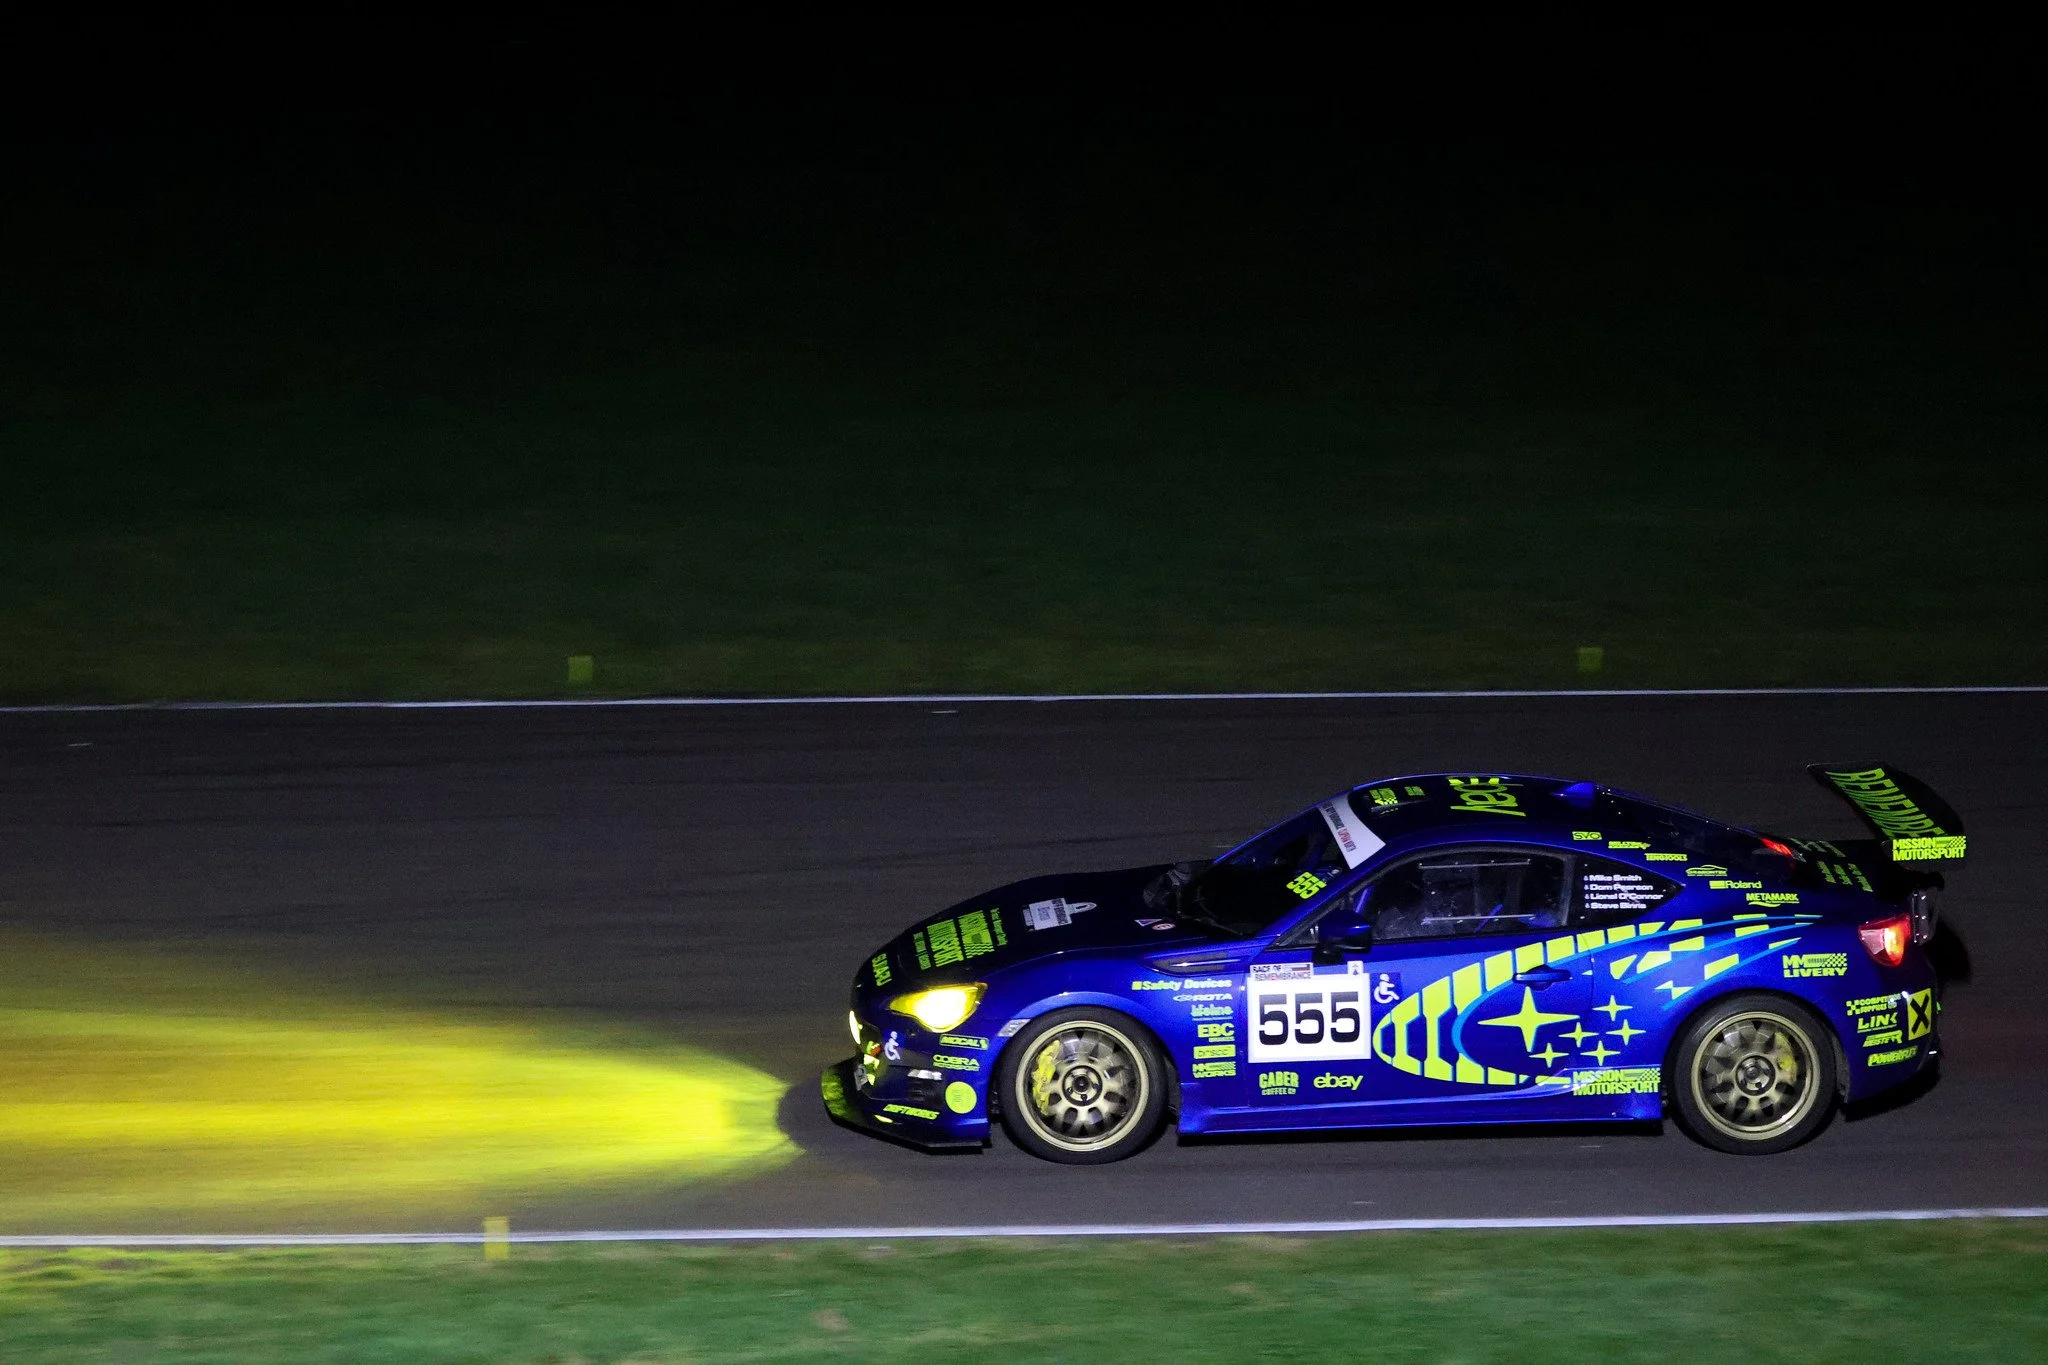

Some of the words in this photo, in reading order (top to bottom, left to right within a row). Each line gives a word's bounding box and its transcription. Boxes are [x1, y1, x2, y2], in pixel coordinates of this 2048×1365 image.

[1573, 832, 1601, 840] SVO
[1892, 837, 1935, 850] MISSION
[1892, 847, 1965, 861] MOTORSPORT
[1613, 874, 1642, 882] Smith
[1286, 872, 1327, 899] 555
[1613, 883, 1654, 891] Pearson
[1725, 880, 1763, 889] Roland
[1618, 892, 1664, 900] O'Connor
[1746, 892, 1800, 902] METAMARK
[1782, 954, 1806, 969] MM
[1253, 965, 1271, 973] RACE
[1273, 964, 1282, 972] OF
[1783, 967, 1848, 978] LIVERY
[1255, 972, 1311, 981] REMEMBRANCE
[1141, 980, 1182, 991] Safety
[1183, 978, 1233, 989] Devices
[1192, 993, 1233, 1001] ROTA
[1258, 991, 1361, 1045] 555
[1858, 1012, 1898, 1030] LINK
[1197, 1022, 1235, 1038] EBC
[933, 1054, 980, 1066] COBRA
[1193, 1069, 1237, 1078] WORKS
[1572, 1070, 1624, 1084] MISSION
[1313, 1072, 1364, 1090] ebay
[1261, 1087, 1288, 1096] COFFEE
[1572, 1081, 1660, 1096] MOTORSPORT
